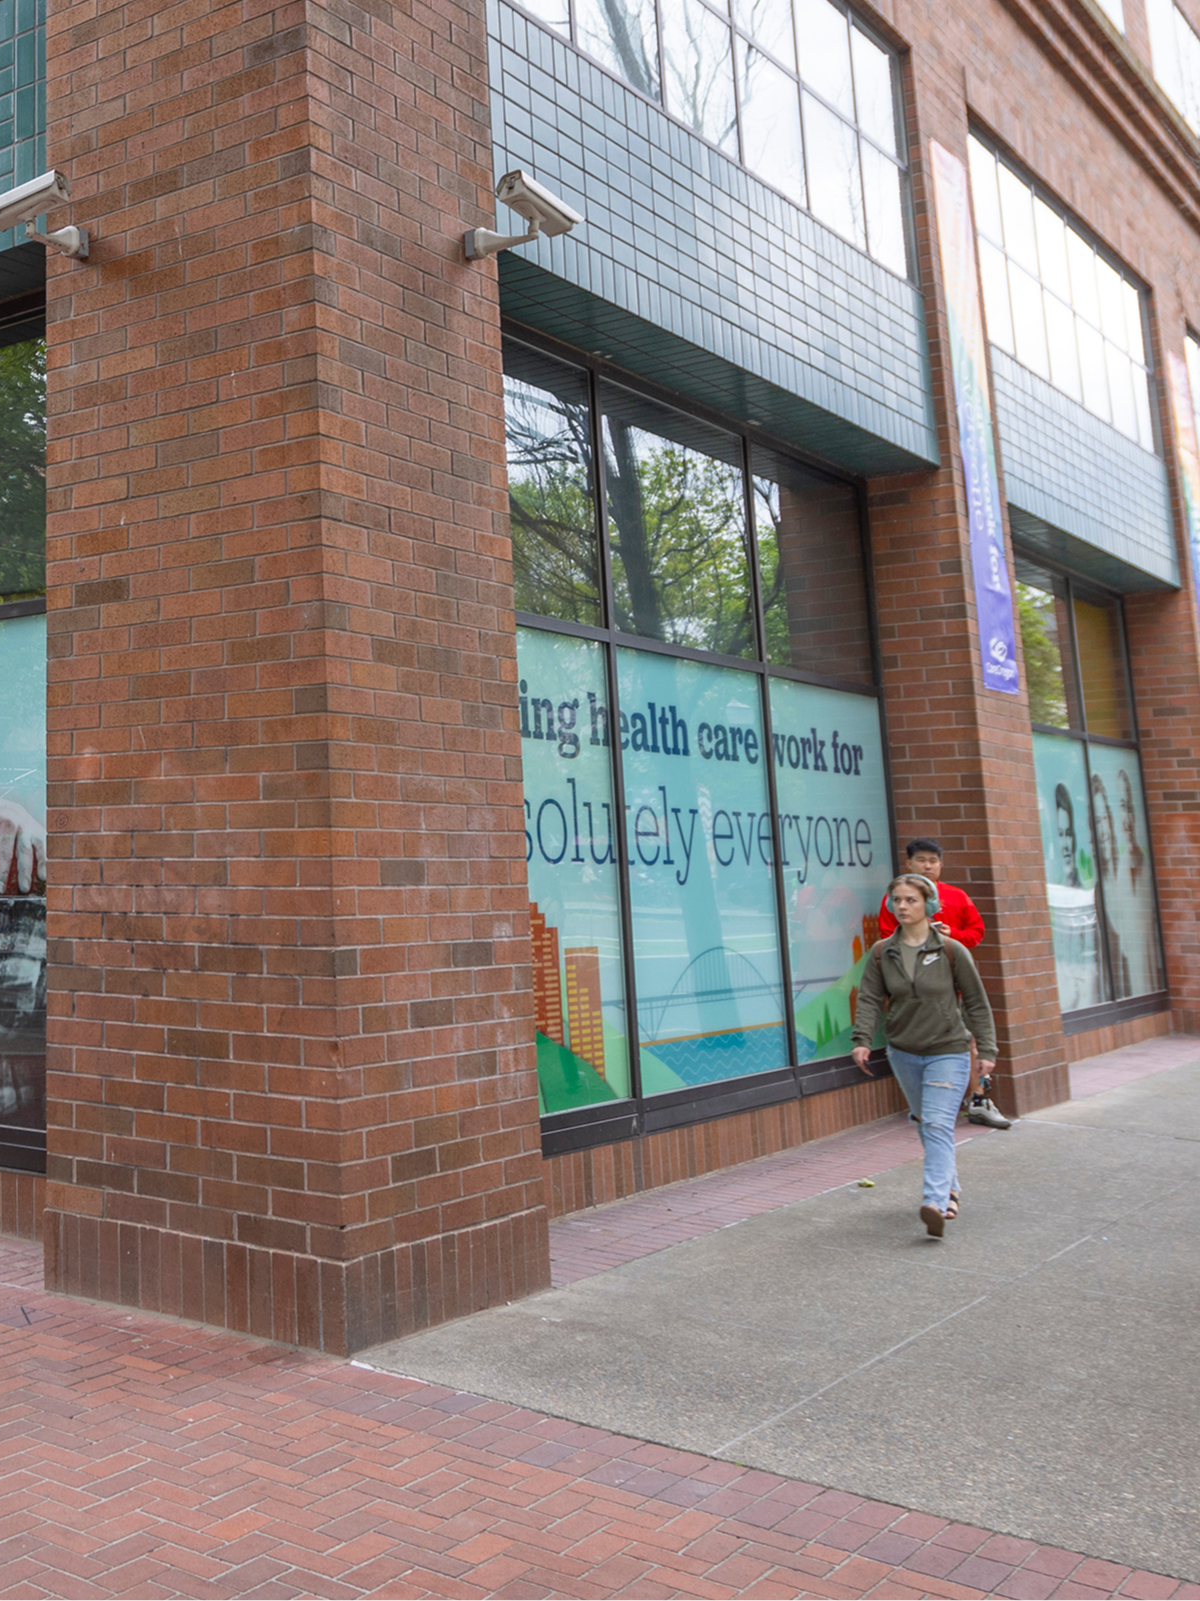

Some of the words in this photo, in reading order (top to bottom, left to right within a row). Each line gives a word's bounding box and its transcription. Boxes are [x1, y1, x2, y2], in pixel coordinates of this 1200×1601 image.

[587, 691, 690, 756] health
[697, 721, 759, 765] care
[772, 727, 828, 772] work
[831, 730, 863, 776] for
[712, 809, 873, 884] everyone
